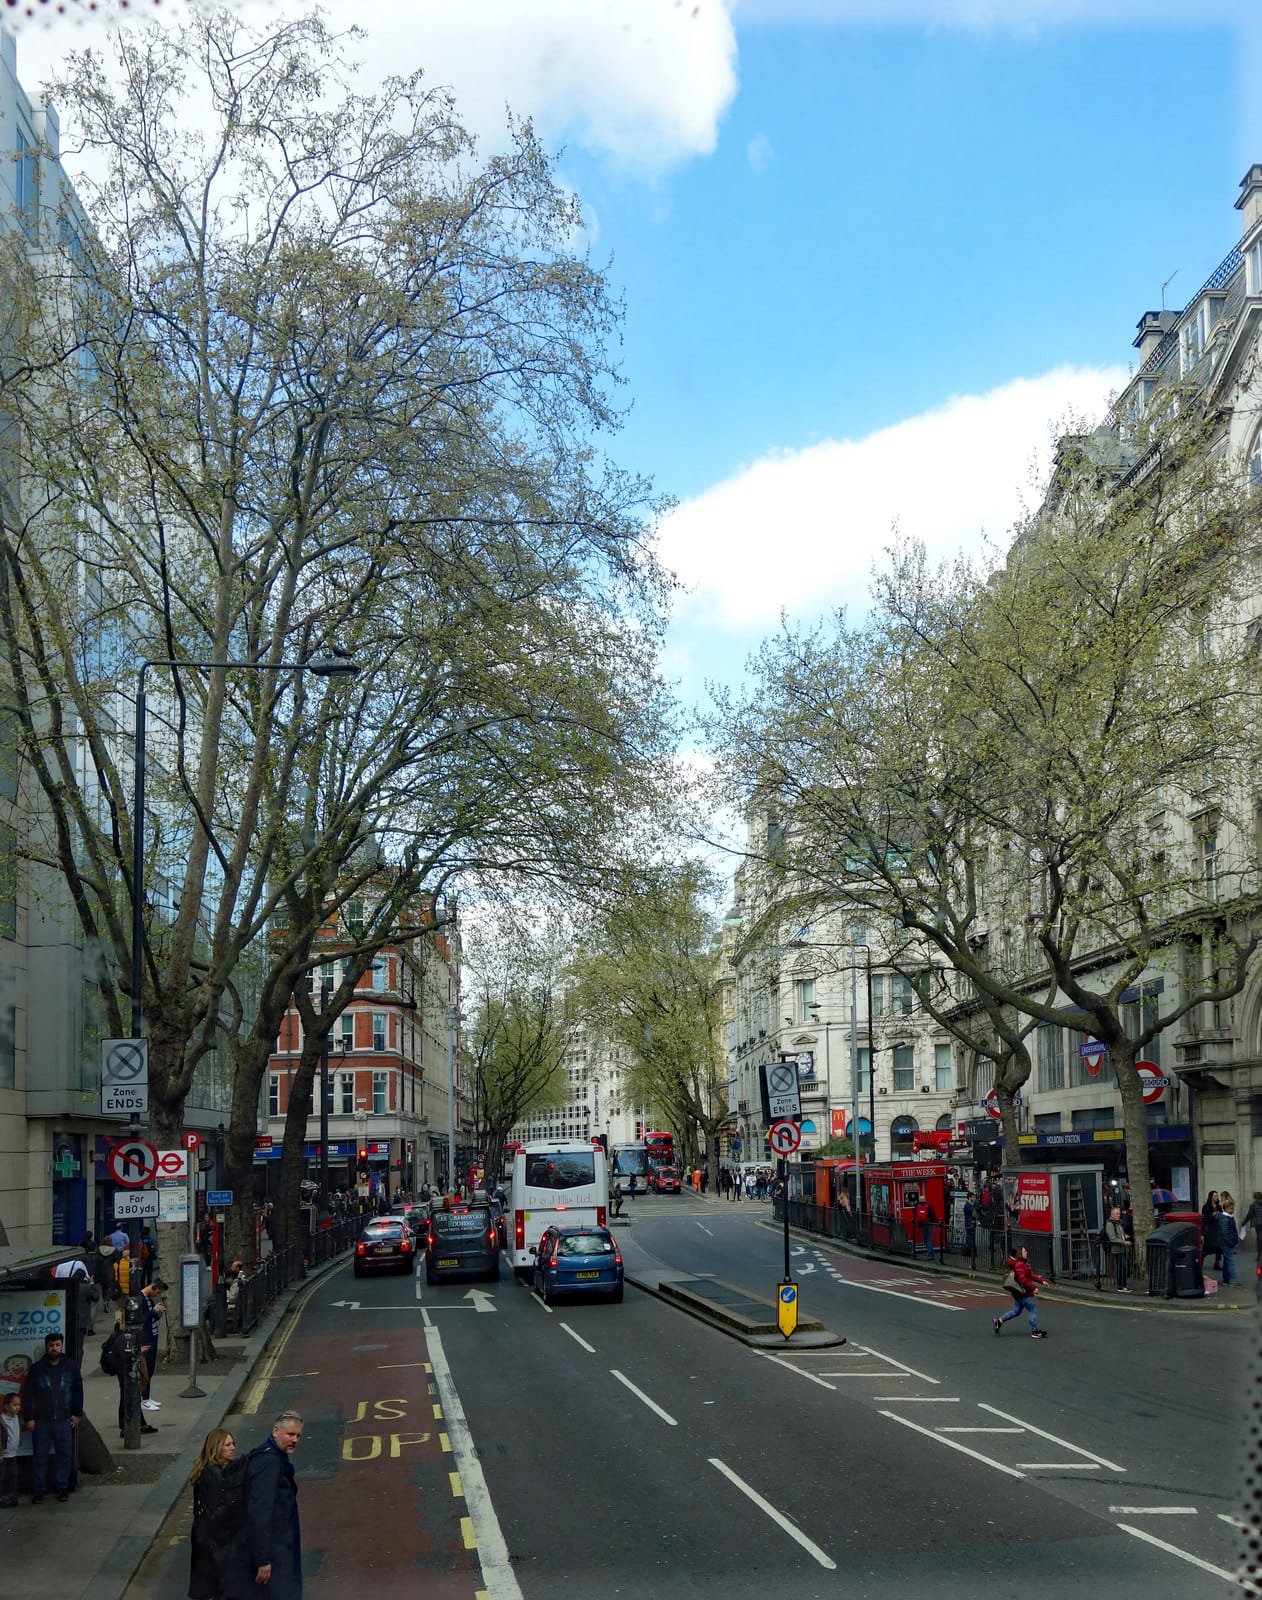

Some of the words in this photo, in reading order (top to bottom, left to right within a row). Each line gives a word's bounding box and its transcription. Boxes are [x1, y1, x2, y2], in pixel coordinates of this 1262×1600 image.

[113, 1088, 137, 1096] Zone
[107, 1098, 144, 1109] ENDS
[773, 1104, 798, 1114] ENDS
[187, 1135, 197, 1148] P
[1046, 1134, 1064, 1144] HOLBORN
[1064, 1134, 1081, 1143] STATION
[901, 1169, 915, 1177] THE
[915, 1168, 937, 1176] WEEK
[129, 1195, 145, 1203] For
[1020, 1194, 1049, 1211] STOMP
[118, 1205, 138, 1214] 380
[139, 1204, 155, 1215] yds
[17, 1309, 62, 1325] ZOO
[39, 1325, 61, 1334] ZOO
[342, 1432, 431, 1461] OP
